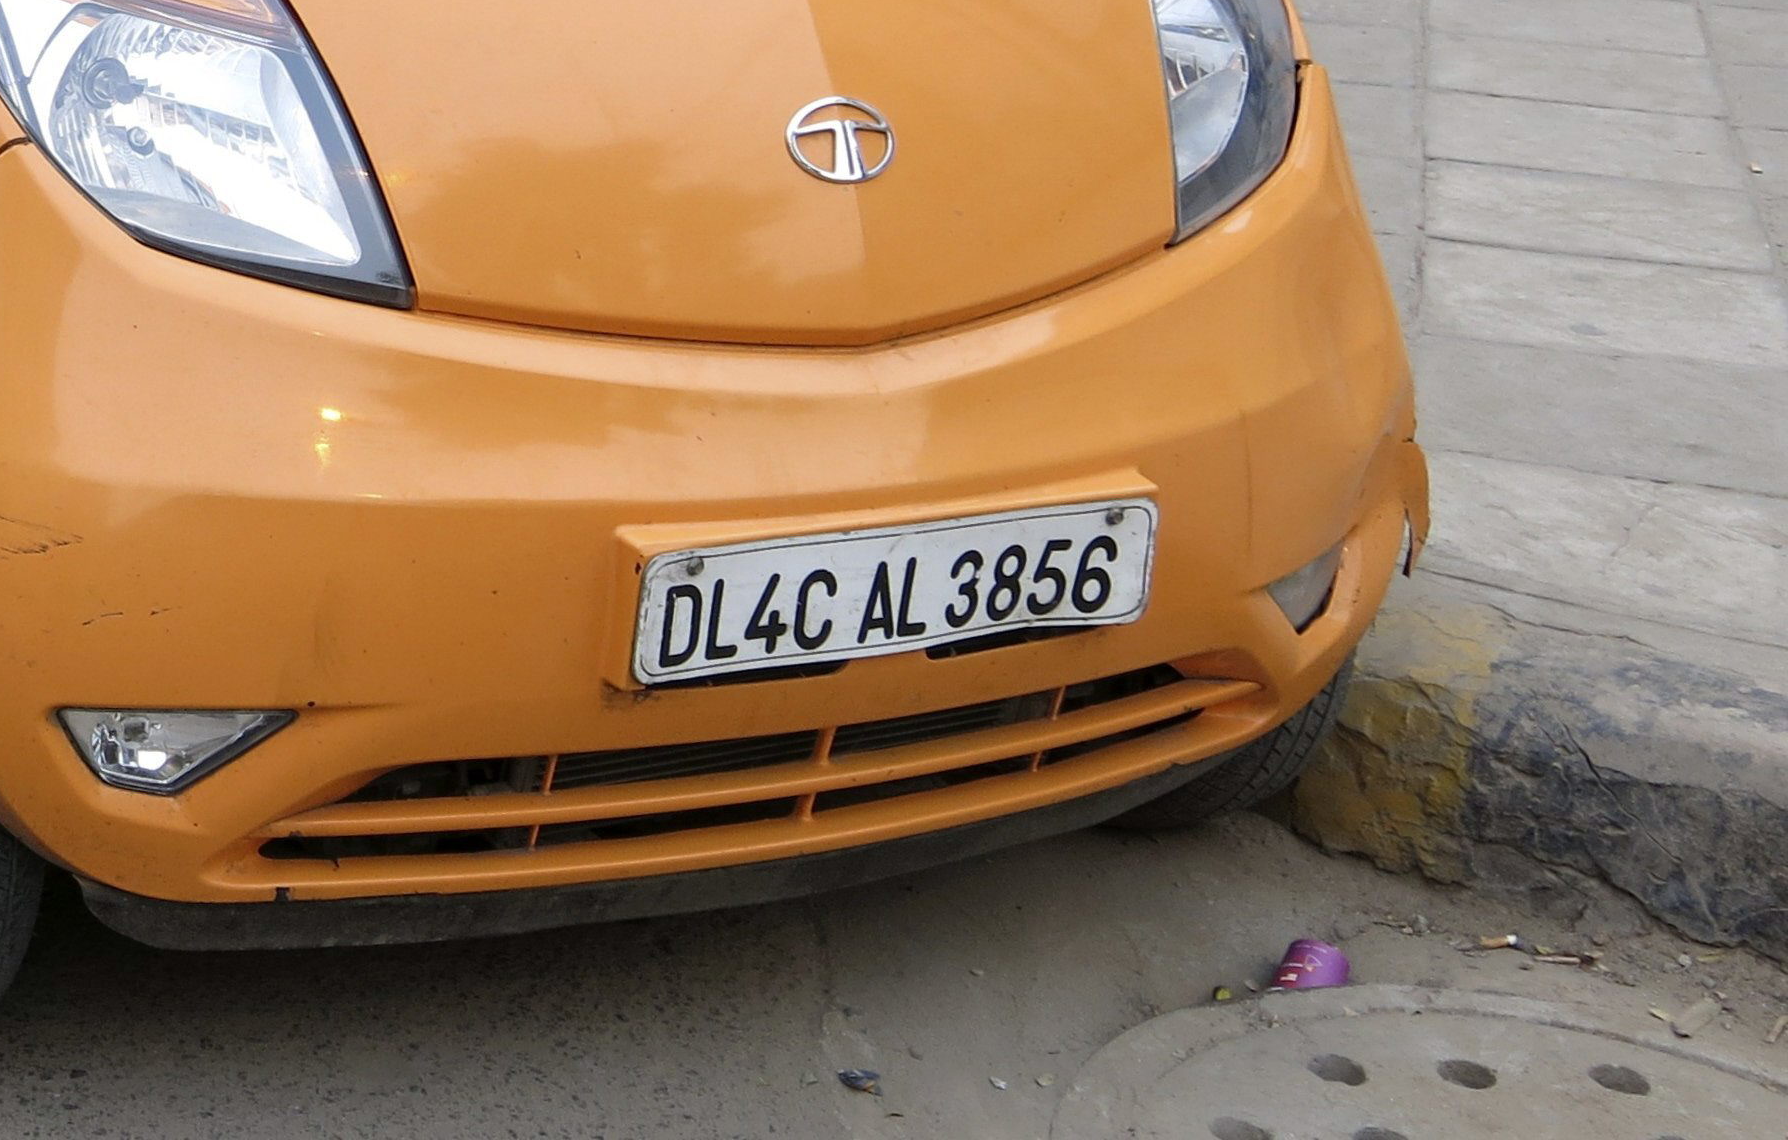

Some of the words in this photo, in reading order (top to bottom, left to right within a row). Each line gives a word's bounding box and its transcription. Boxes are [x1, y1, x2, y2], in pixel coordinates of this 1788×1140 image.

[658, 568, 838, 668] DL4C
[856, 556, 927, 644] AL
[944, 534, 1119, 629] 3856
